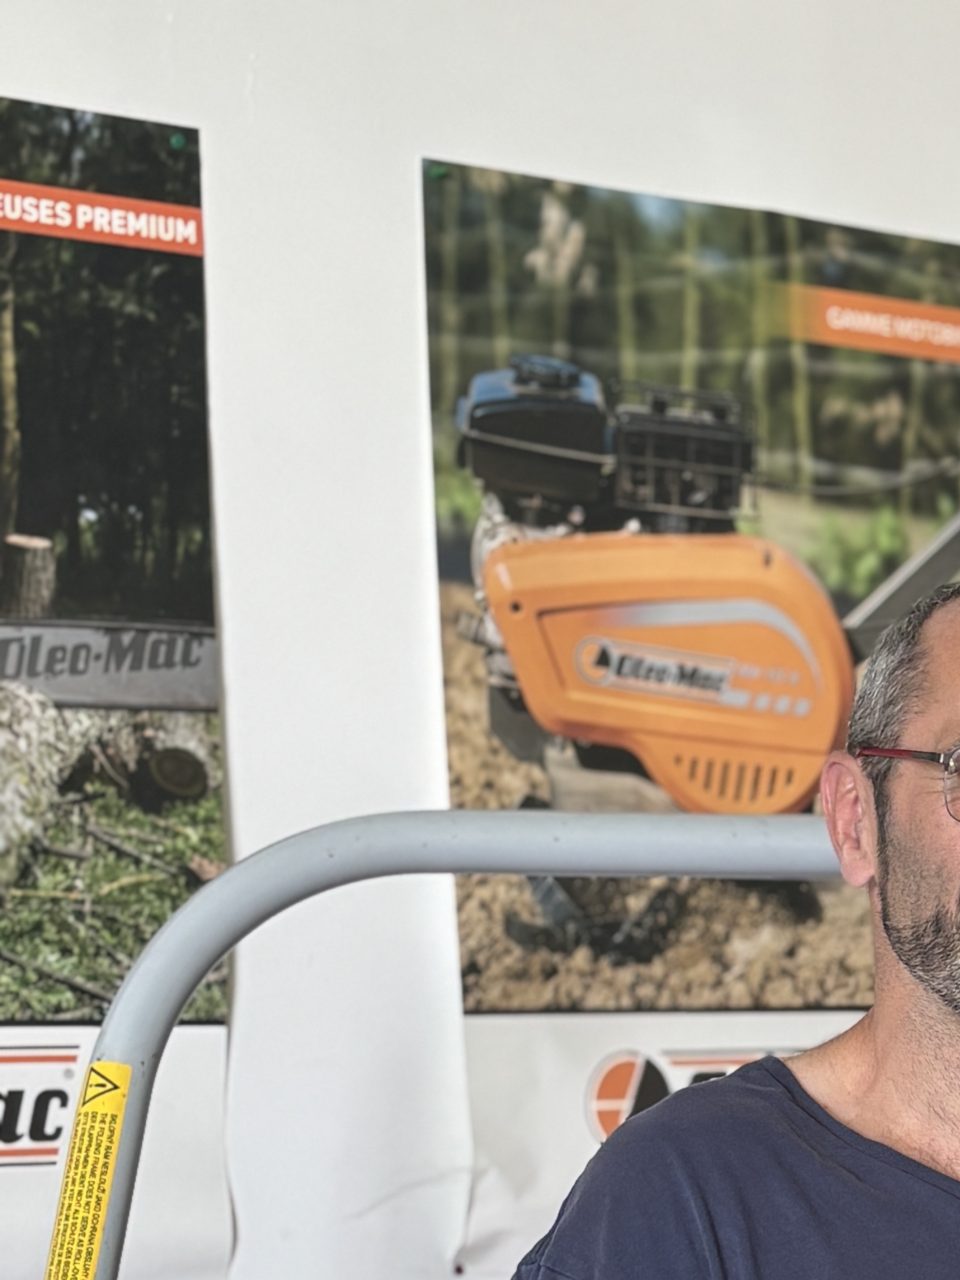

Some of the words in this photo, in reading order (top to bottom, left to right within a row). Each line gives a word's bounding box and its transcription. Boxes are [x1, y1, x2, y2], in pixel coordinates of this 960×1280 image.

[76, 204, 197, 245] PREMIUM
[98, 1112, 107, 1124] THE
[93, 1126, 104, 1155] FOLDING
[88, 1156, 99, 1178] FRAME
[85, 1179, 94, 1199] DOES
[82, 1200, 91, 1214] NOT
[76, 1238, 84, 1247] AS
